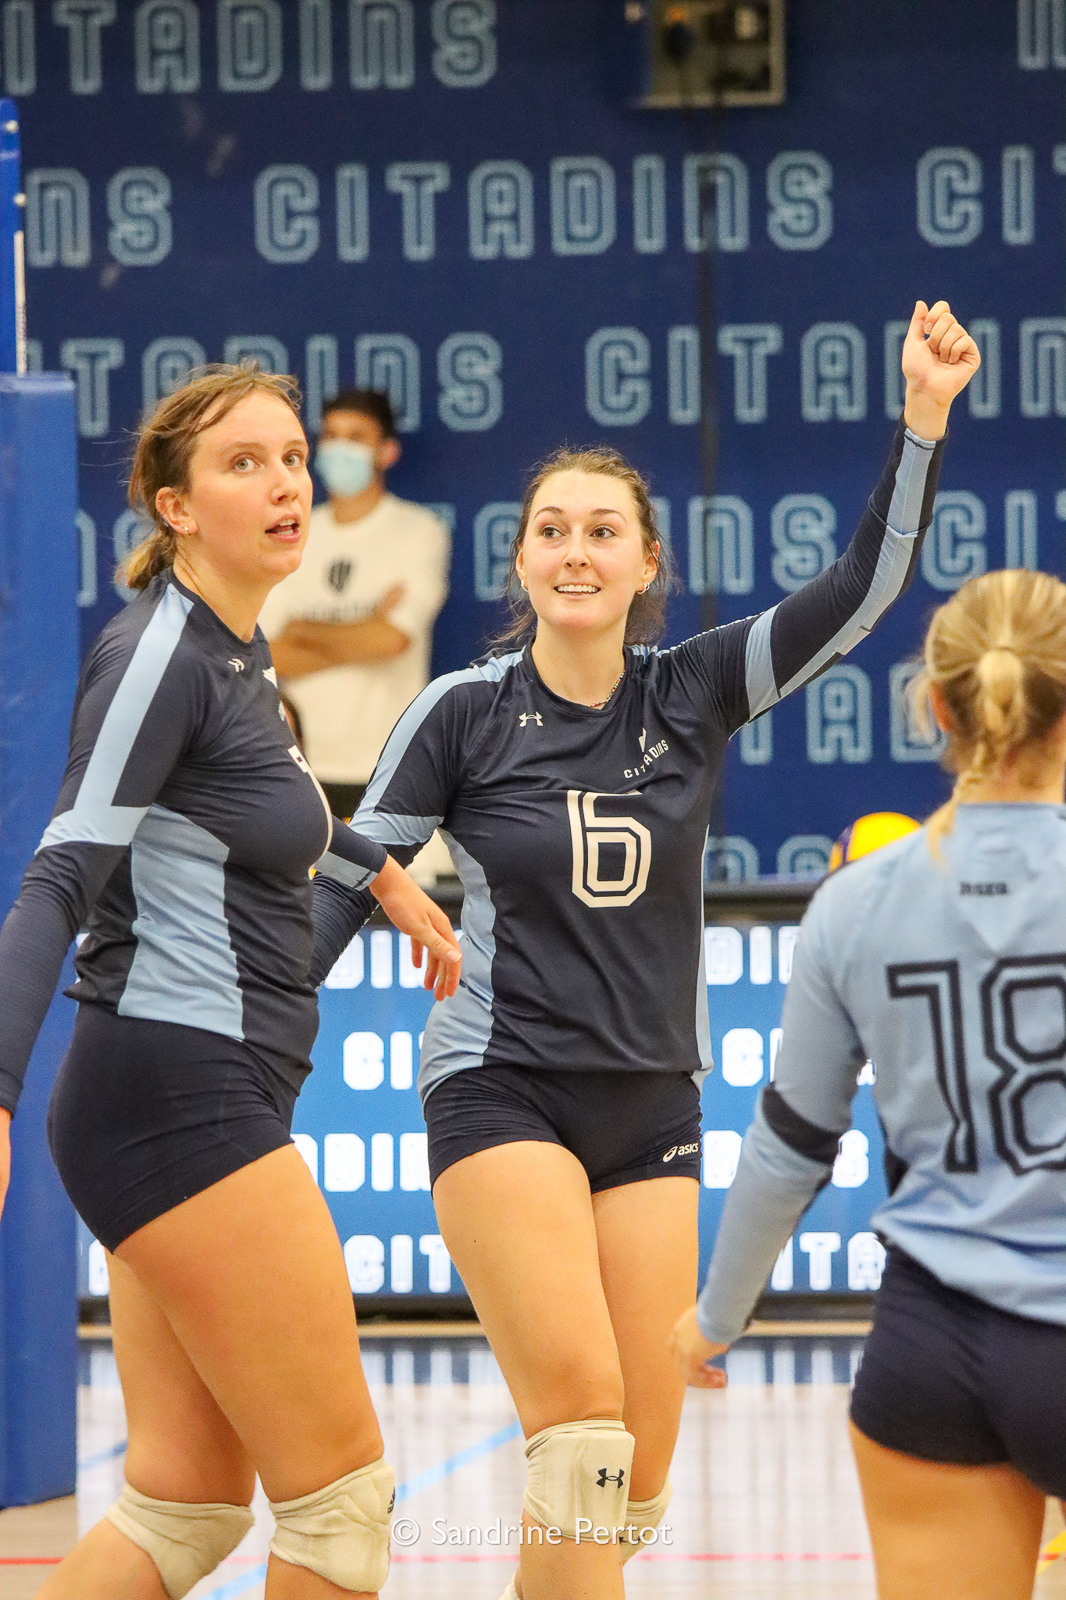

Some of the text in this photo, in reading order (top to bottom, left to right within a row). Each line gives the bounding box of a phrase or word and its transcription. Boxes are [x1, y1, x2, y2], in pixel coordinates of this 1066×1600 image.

[253, 151, 833, 264] CITADINS
[916, 145, 1066, 247] CI
[585, 318, 1066, 426] CITAIN
[921, 489, 1066, 592] CI
[623, 739, 669, 779] CITADINS
[567, 789, 652, 908] 6
[343, 1031, 425, 1090] CI
[886, 952, 1066, 1177] 18
